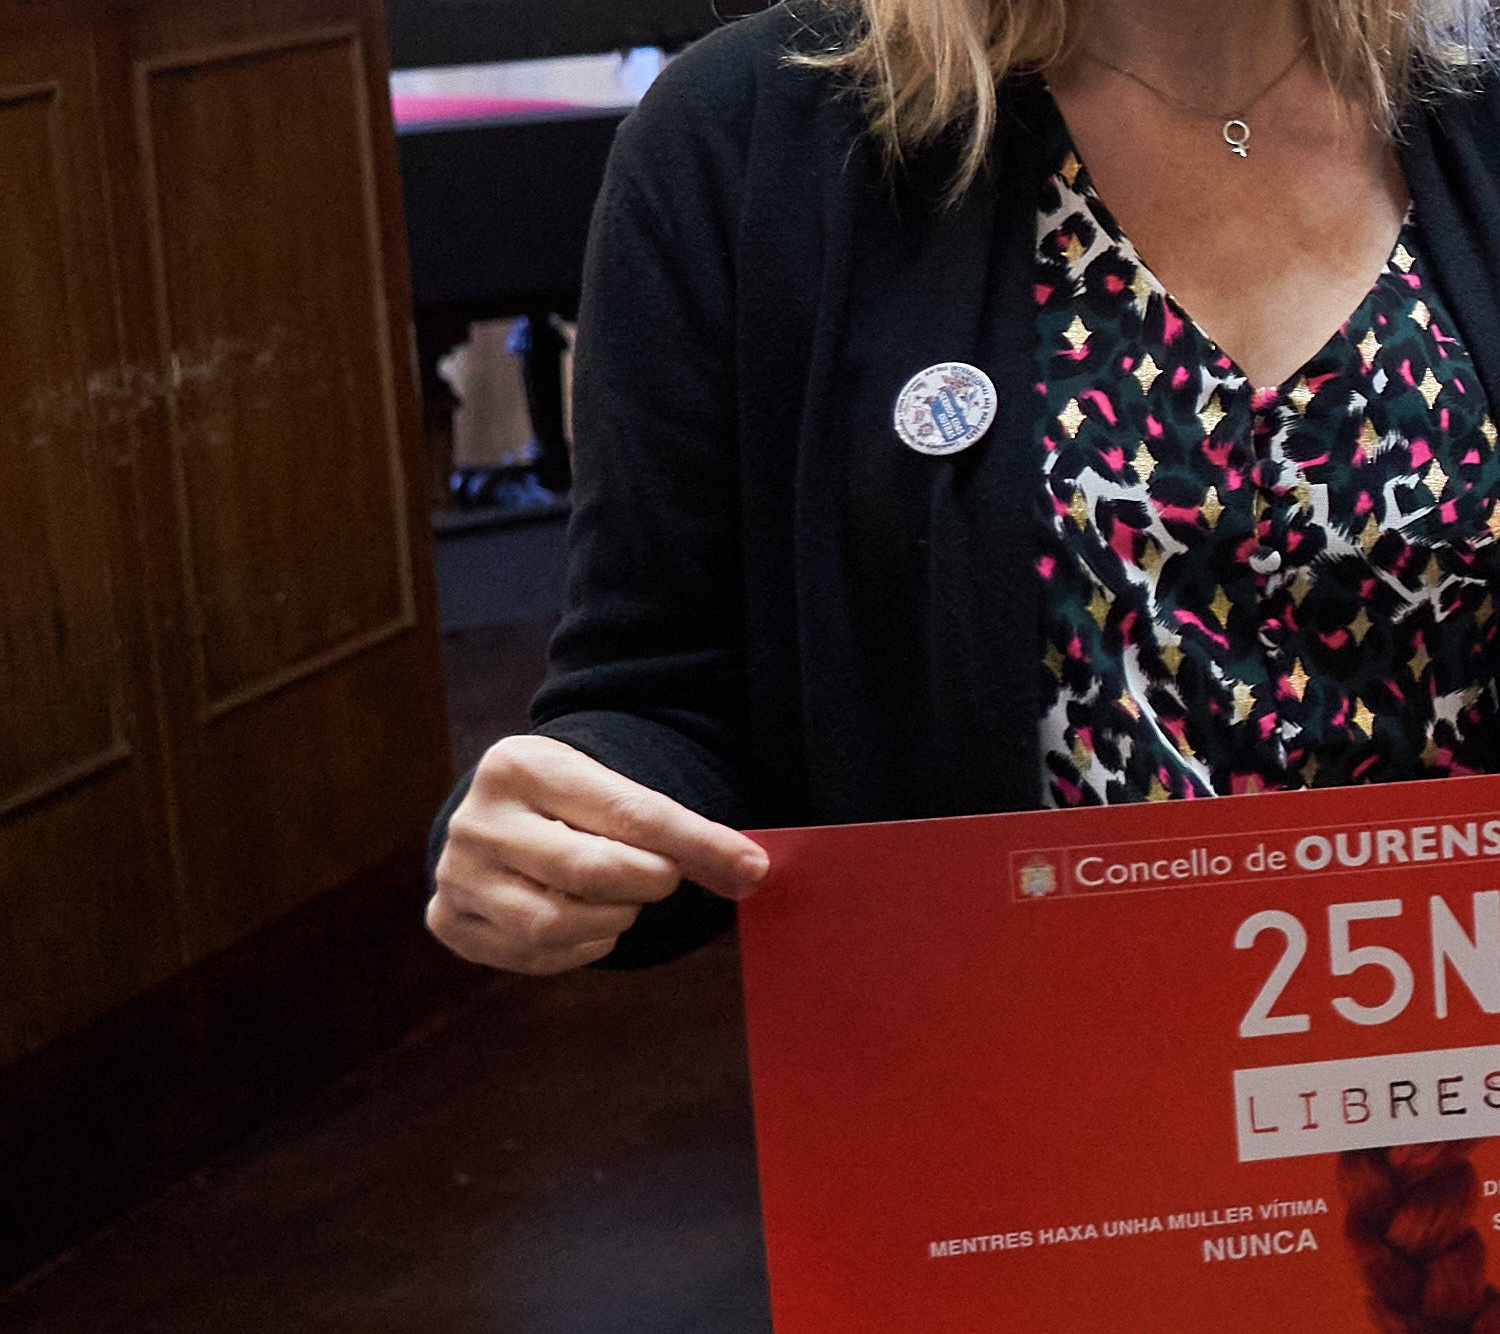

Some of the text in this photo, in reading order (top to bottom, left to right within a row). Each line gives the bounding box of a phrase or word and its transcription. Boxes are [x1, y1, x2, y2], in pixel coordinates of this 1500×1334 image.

[1074, 847, 1232, 886] Concello
[1244, 842, 1286, 872] de
[928, 1197, 1328, 1258] MENTRES HAXA UNHA MULLER VÍTIMA
[1202, 1227, 1318, 1262] NUNCA
